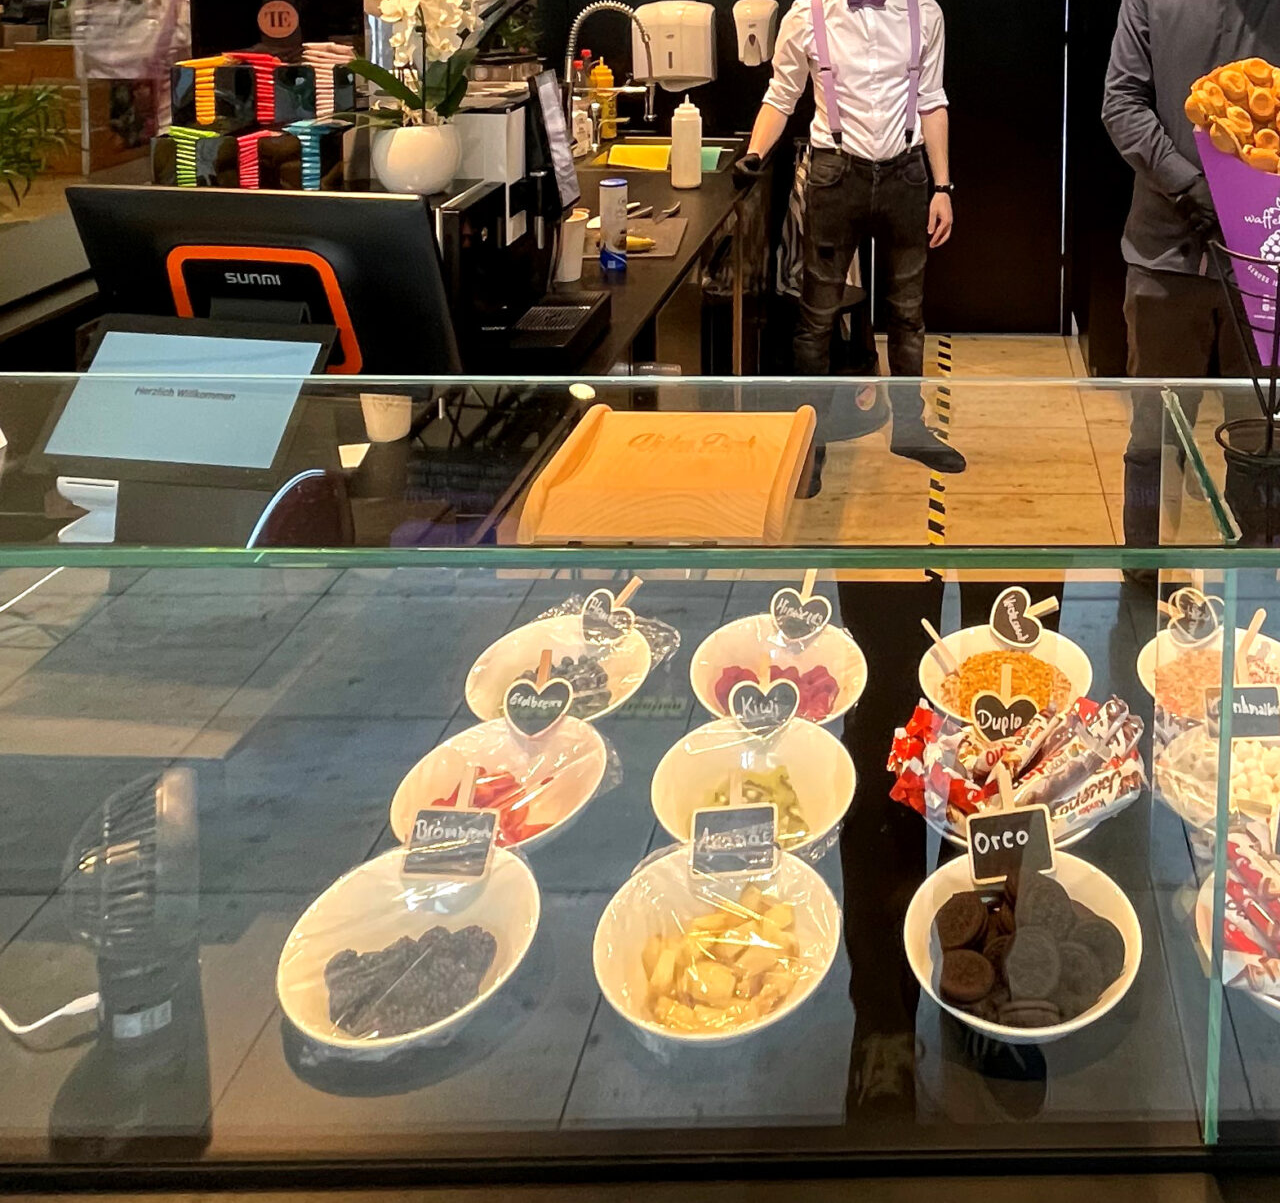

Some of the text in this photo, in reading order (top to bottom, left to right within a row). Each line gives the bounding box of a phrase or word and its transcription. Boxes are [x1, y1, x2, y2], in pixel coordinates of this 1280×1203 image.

[224, 271, 282, 287] SUNMI
[134, 385, 236, 402] Herzlich Willkommen
[740, 695, 779, 717] Kiwi
[976, 708, 1023, 735] Duplo
[974, 829, 1030, 854] Oreo
